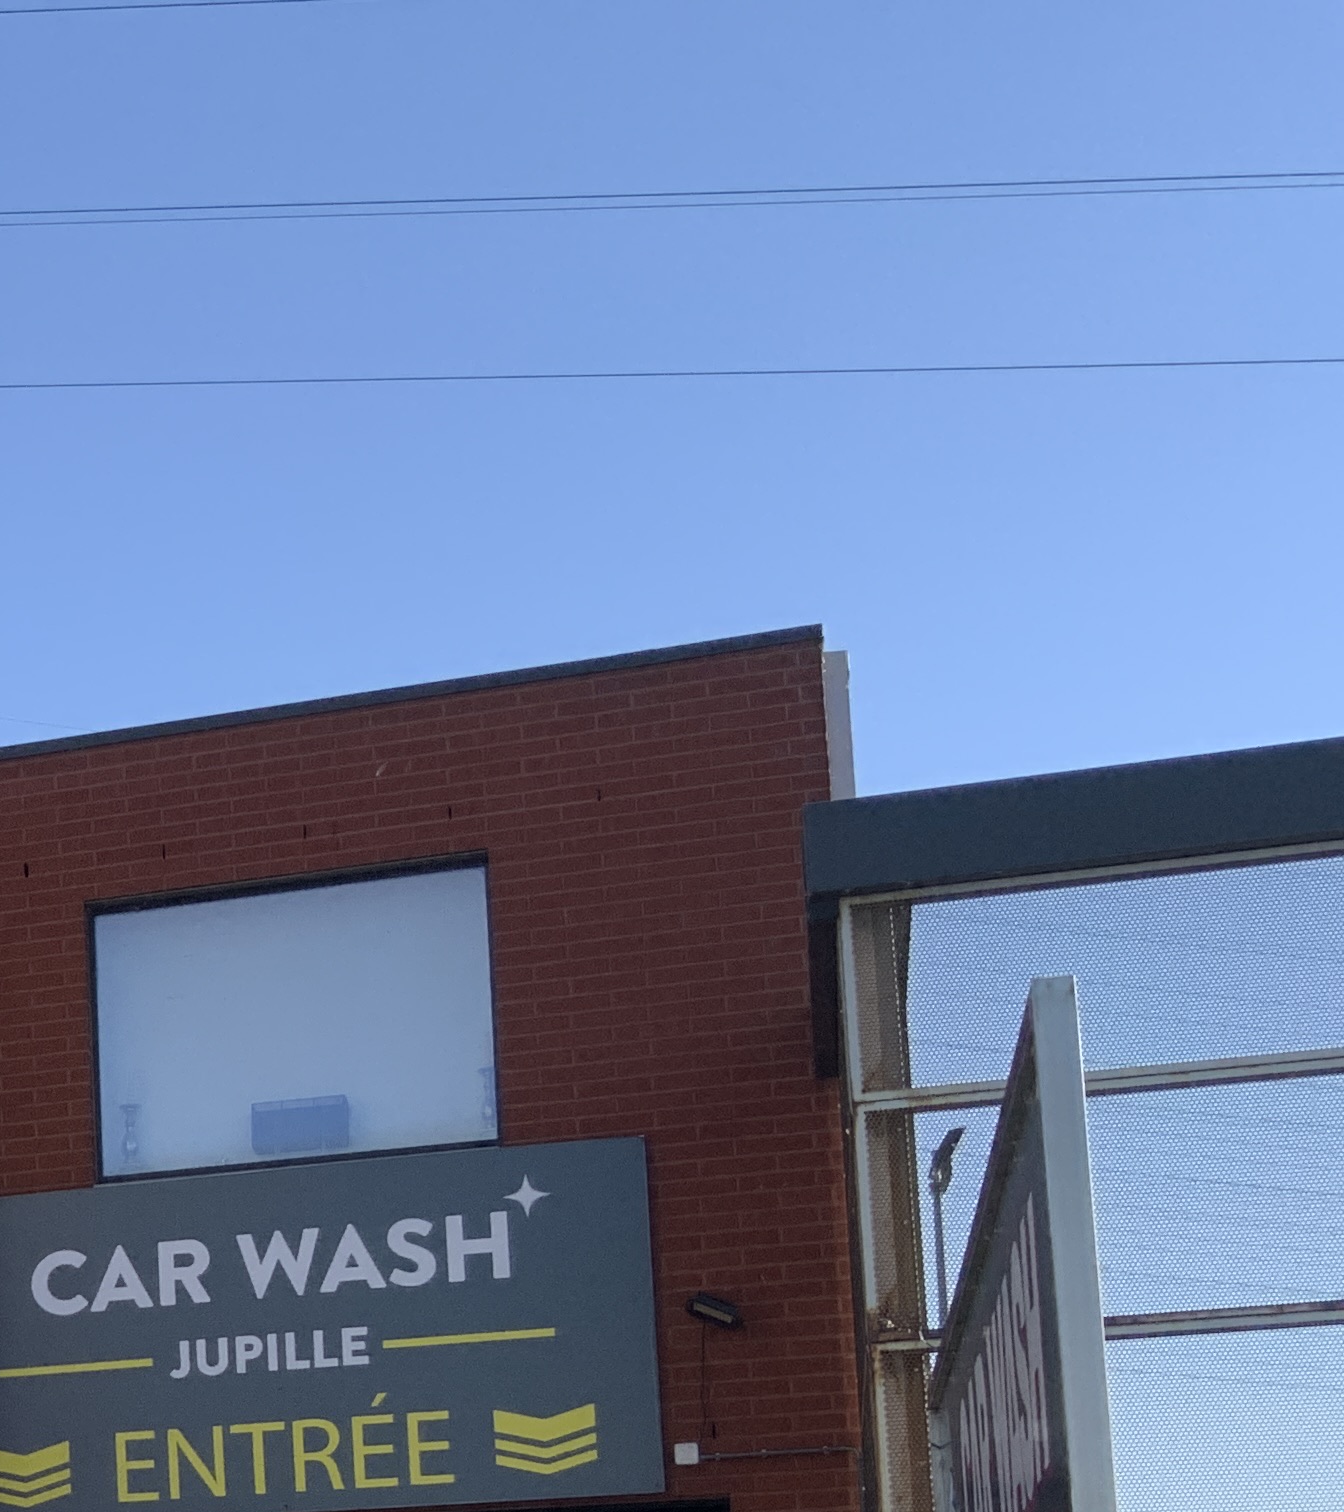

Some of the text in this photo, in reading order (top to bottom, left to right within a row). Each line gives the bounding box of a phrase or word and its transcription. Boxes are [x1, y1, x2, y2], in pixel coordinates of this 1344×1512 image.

[30, 1210, 511, 1317] CAR WASH
[170, 1326, 370, 1380] JUPILLE
[115, 1393, 456, 1504] ENTRÉE
